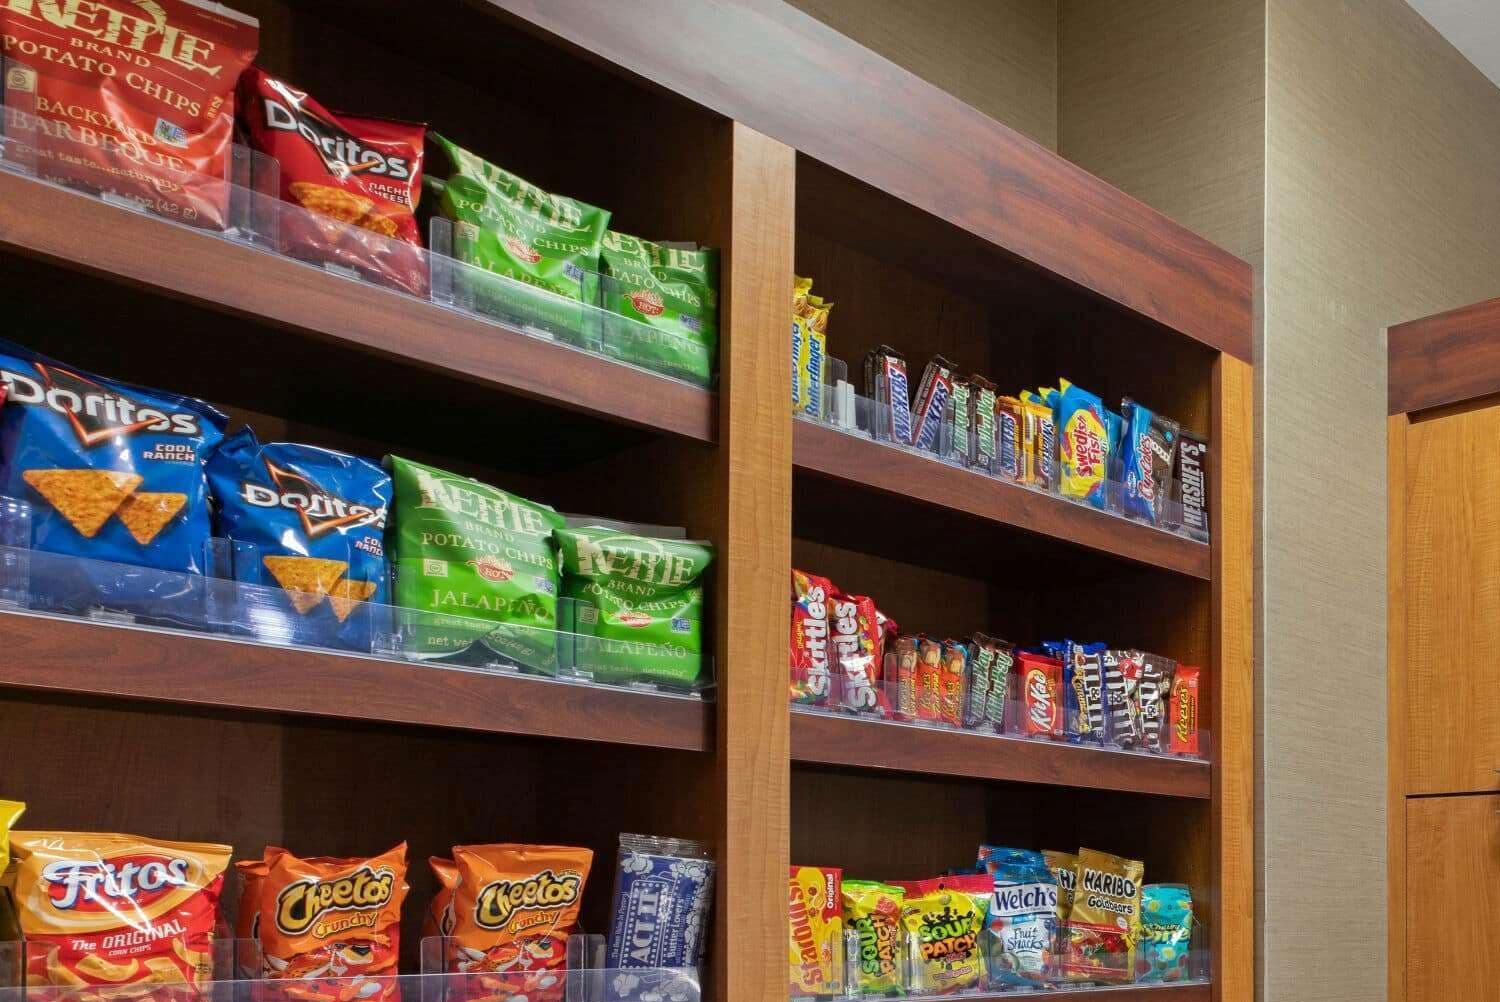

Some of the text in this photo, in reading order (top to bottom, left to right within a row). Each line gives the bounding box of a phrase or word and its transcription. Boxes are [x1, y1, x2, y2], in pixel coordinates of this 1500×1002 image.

[70, 37, 151, 68] BRAND
[3, 35, 201, 117] POTATO CHIPS
[10, 109, 189, 175] BARBEQUE
[265, 99, 409, 179] Doritos
[532, 236, 590, 258] CHIPS
[2, 370, 198, 435] Doritos
[142, 450, 195, 462] RANCH
[154, 443, 194, 453] COOL
[1075, 414, 1093, 478] Swedish
[1087, 431, 1102, 470] Fish
[414, 467, 545, 537] KETTLE
[1180, 441, 1202, 528] HERSHEY'S
[421, 532, 554, 571] POTATO CHIPS
[575, 533, 695, 586] KETTLE
[607, 578, 657, 598] BRAND
[804, 586, 830, 697] Skittles
[833, 602, 877, 708] Skittles
[42, 857, 189, 910] Fritos
[278, 869, 395, 934] Cheetos
[476, 870, 582, 930] Cheetos
[826, 873, 835, 910] Original
[995, 887, 1056, 912] Welch's
[1084, 869, 1136, 899] HARIBO
[507, 911, 560, 934] Crunchy
[1087, 895, 1133, 914] Goldbears
[71, 918, 188, 952] The ORIGINAL
[312, 911, 379, 939] Crunchy
[630, 891, 660, 963] ACT II
[666, 928, 679, 959] Butter
[870, 912, 895, 975] PATCH
[918, 918, 974, 943] SOUR
[1006, 935, 1044, 951] Snacks
[1013, 926, 1039, 941] Fruit
[107, 944, 152, 957] CORN CHIPS
[855, 918, 880, 975] SOUR
[920, 932, 977, 961] PATCH
